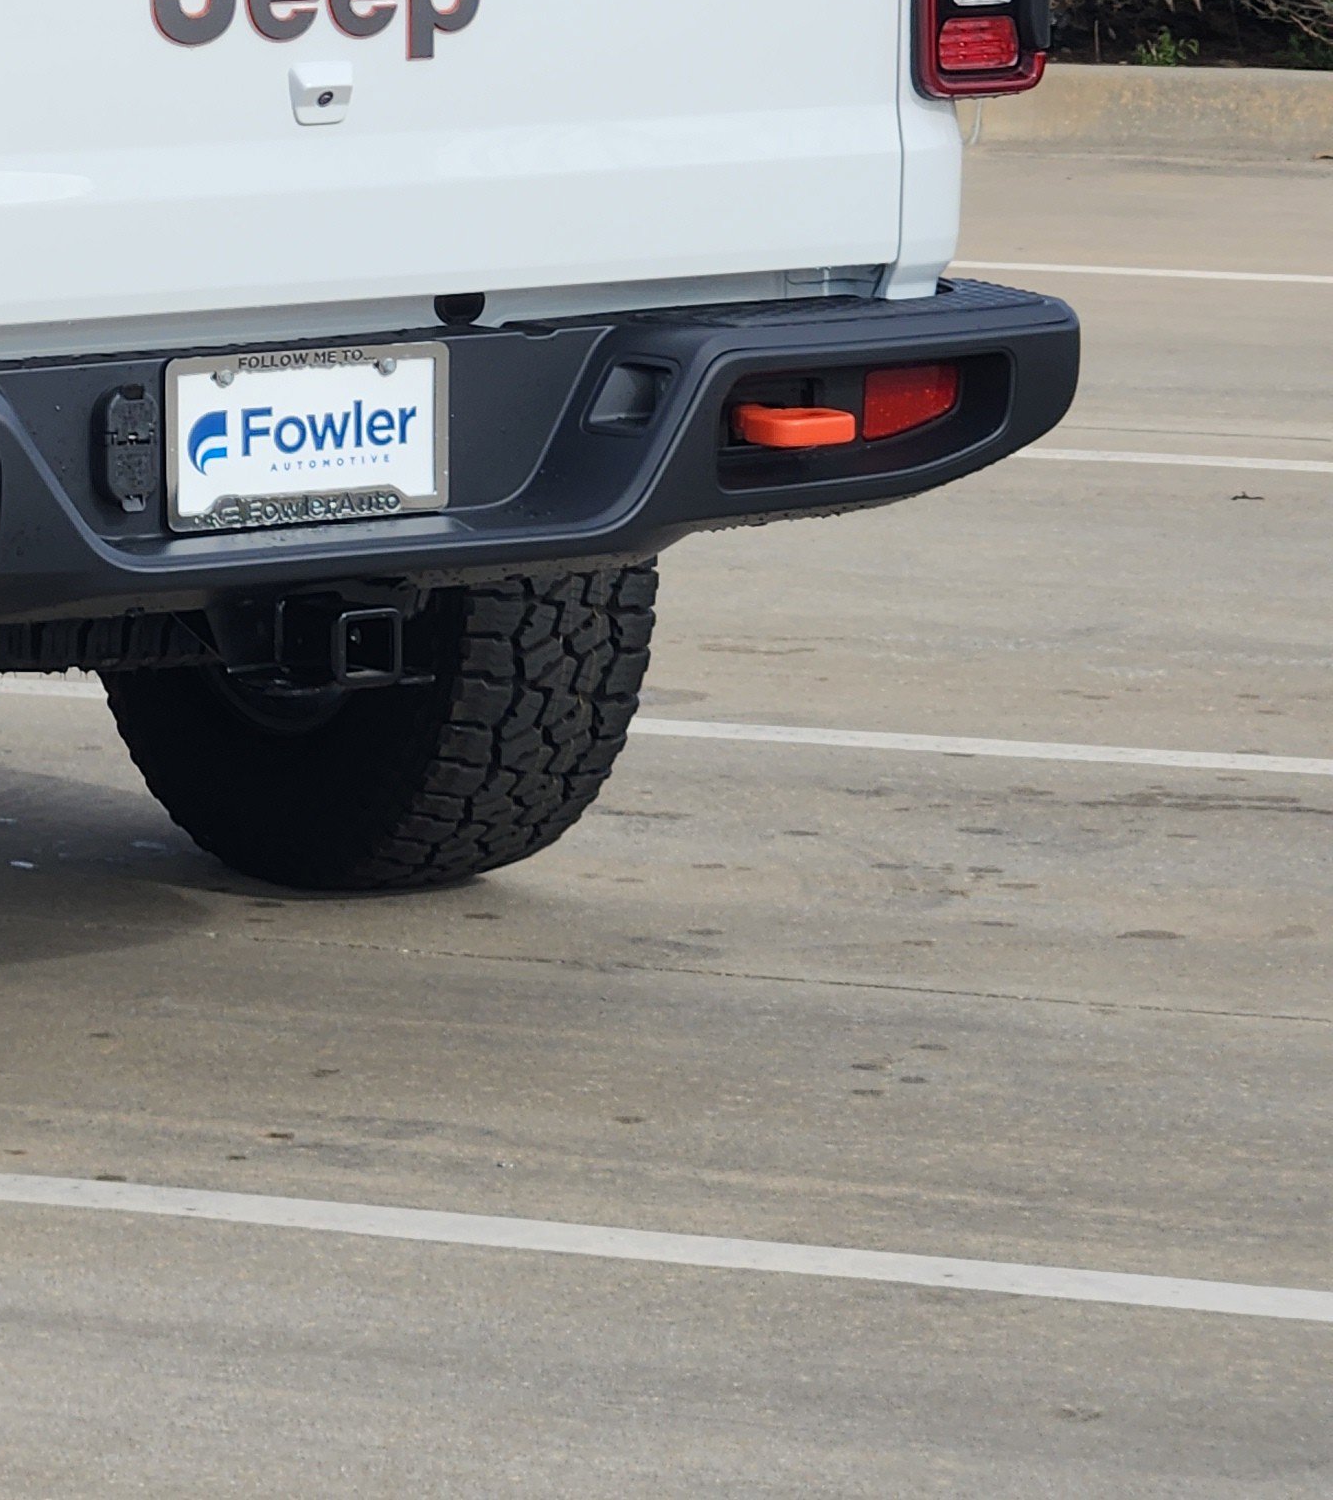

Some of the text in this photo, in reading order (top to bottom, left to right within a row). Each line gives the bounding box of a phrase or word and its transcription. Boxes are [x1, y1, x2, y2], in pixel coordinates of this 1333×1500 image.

[238, 351, 309, 370] FOLLOW
[314, 350, 337, 365] ME
[241, 399, 417, 457] Fowler
[270, 453, 391, 472] AUTOMOTIVE
